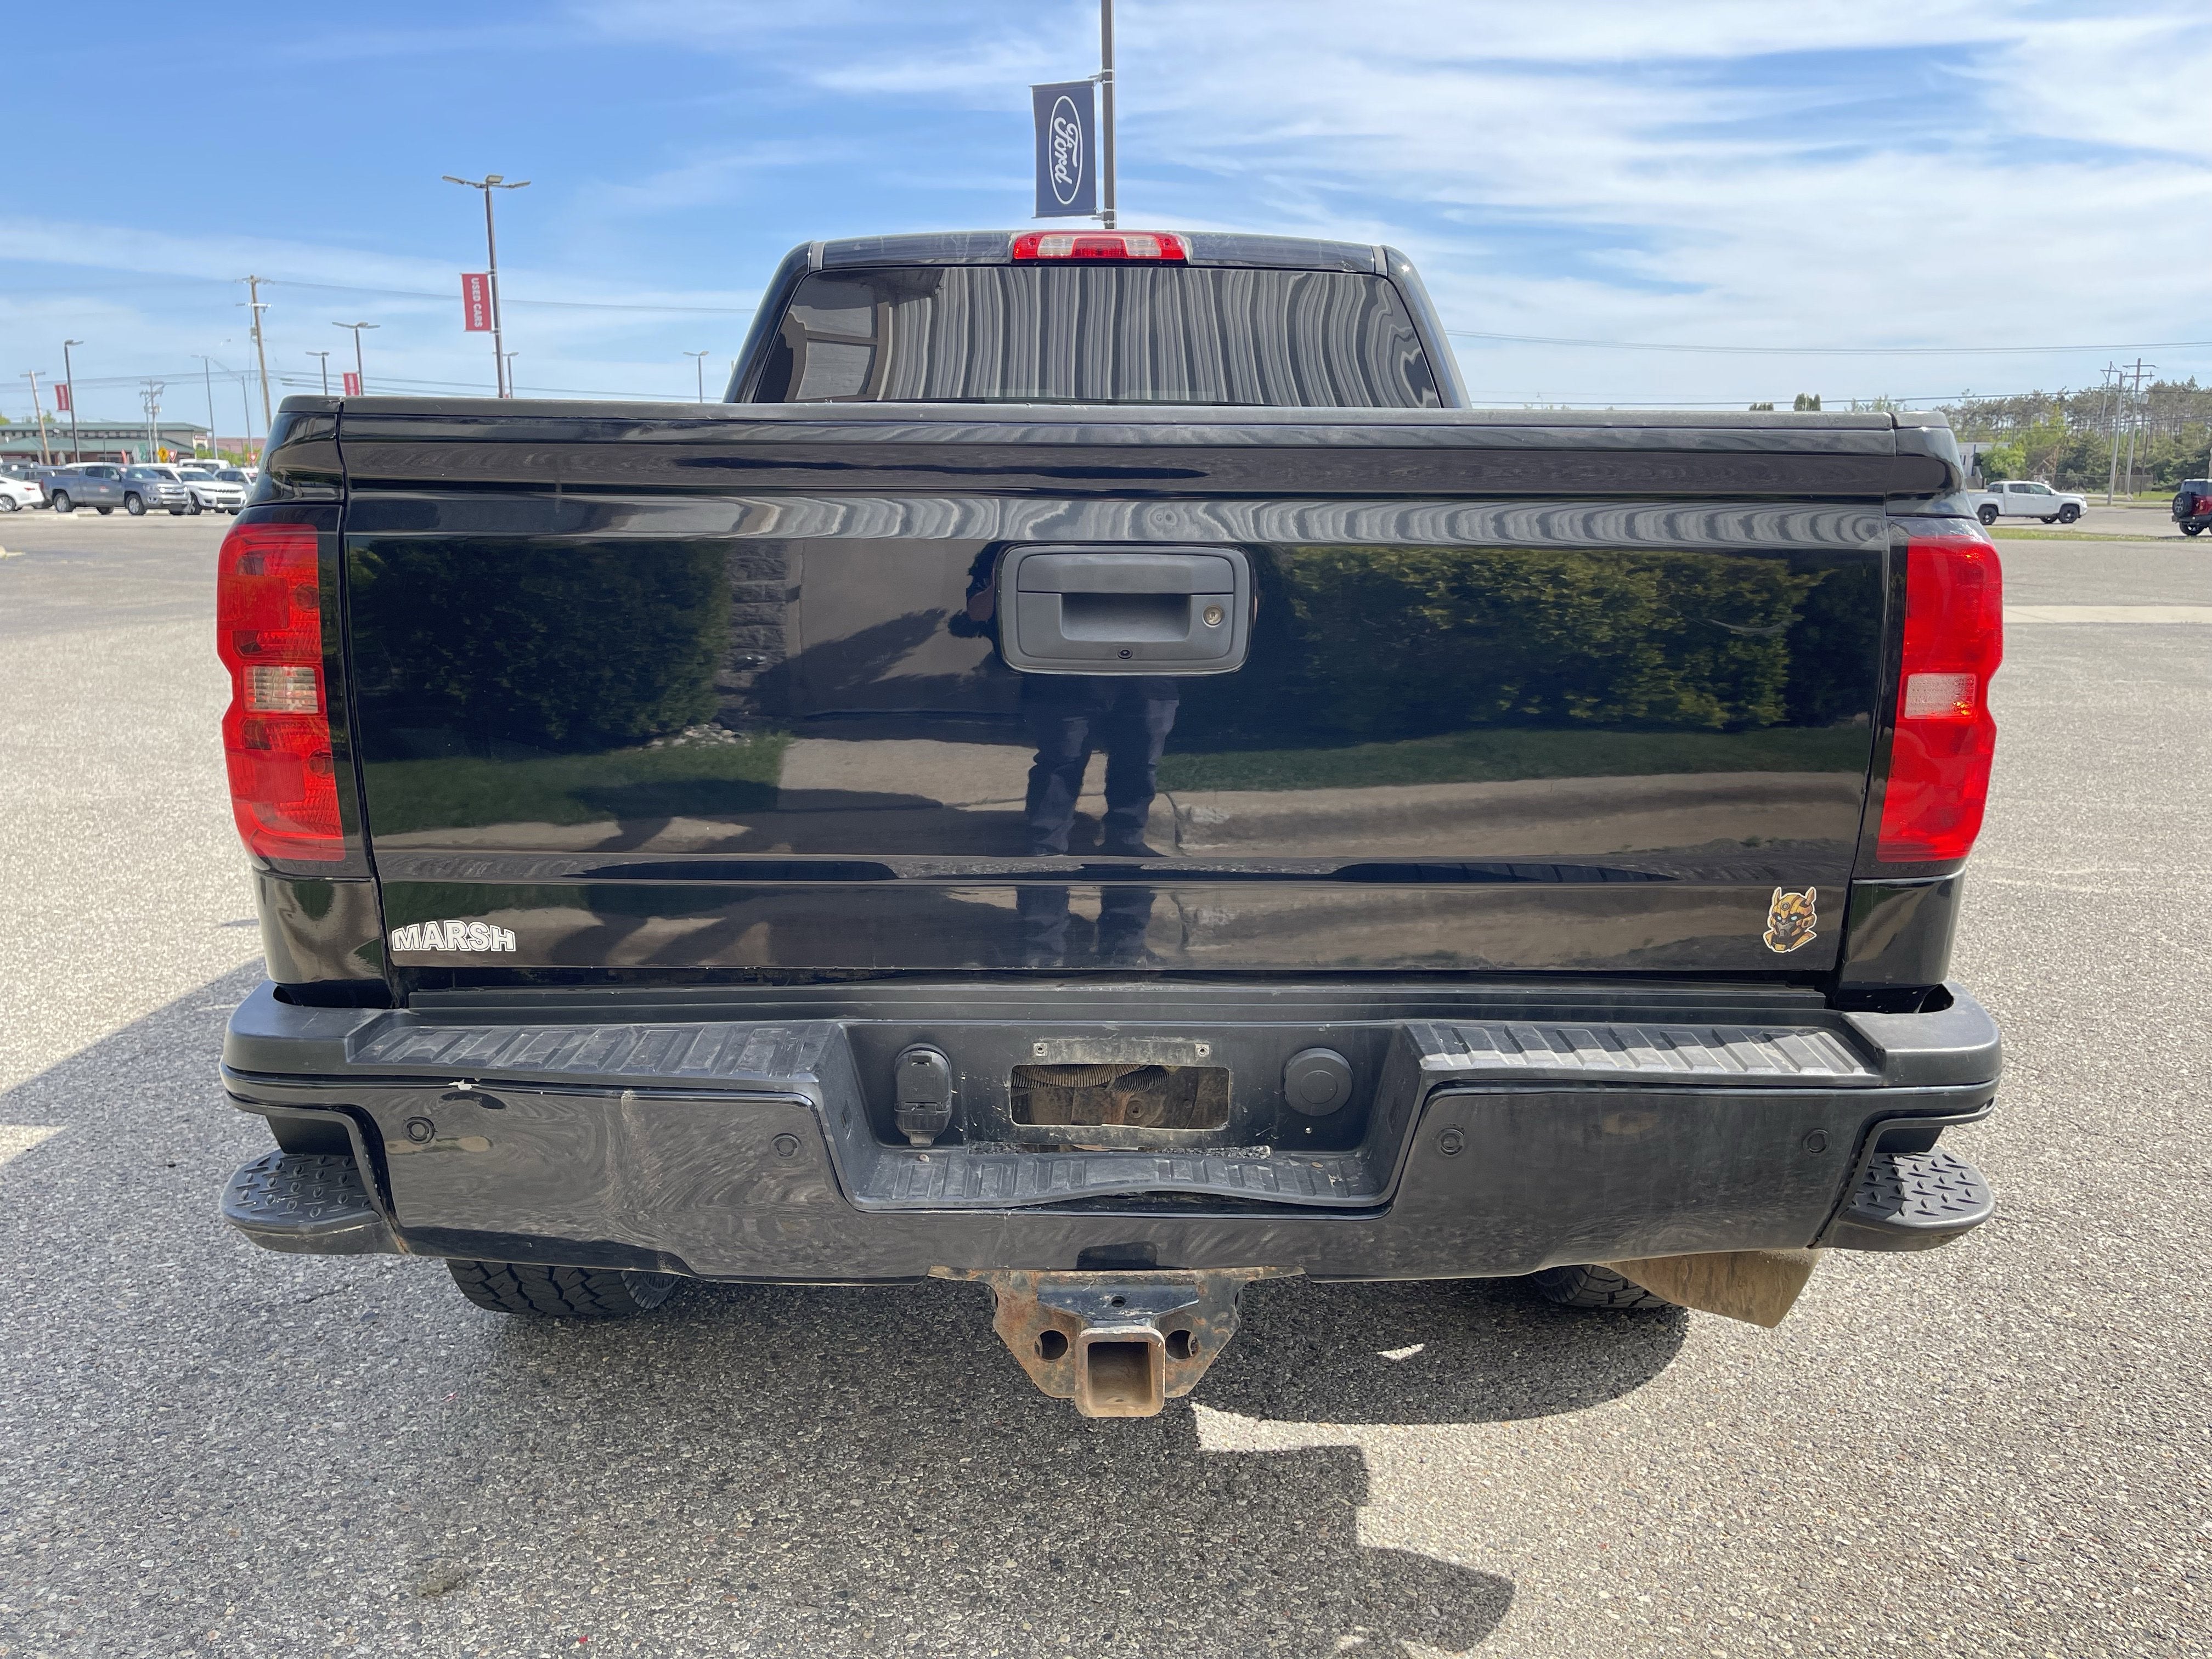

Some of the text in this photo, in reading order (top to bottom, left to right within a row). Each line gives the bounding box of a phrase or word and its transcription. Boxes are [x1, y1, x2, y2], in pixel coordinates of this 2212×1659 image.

[1054, 117, 1077, 184] Ford
[471, 277, 483, 328] USED CARS
[392, 919, 516, 952] MARSH
